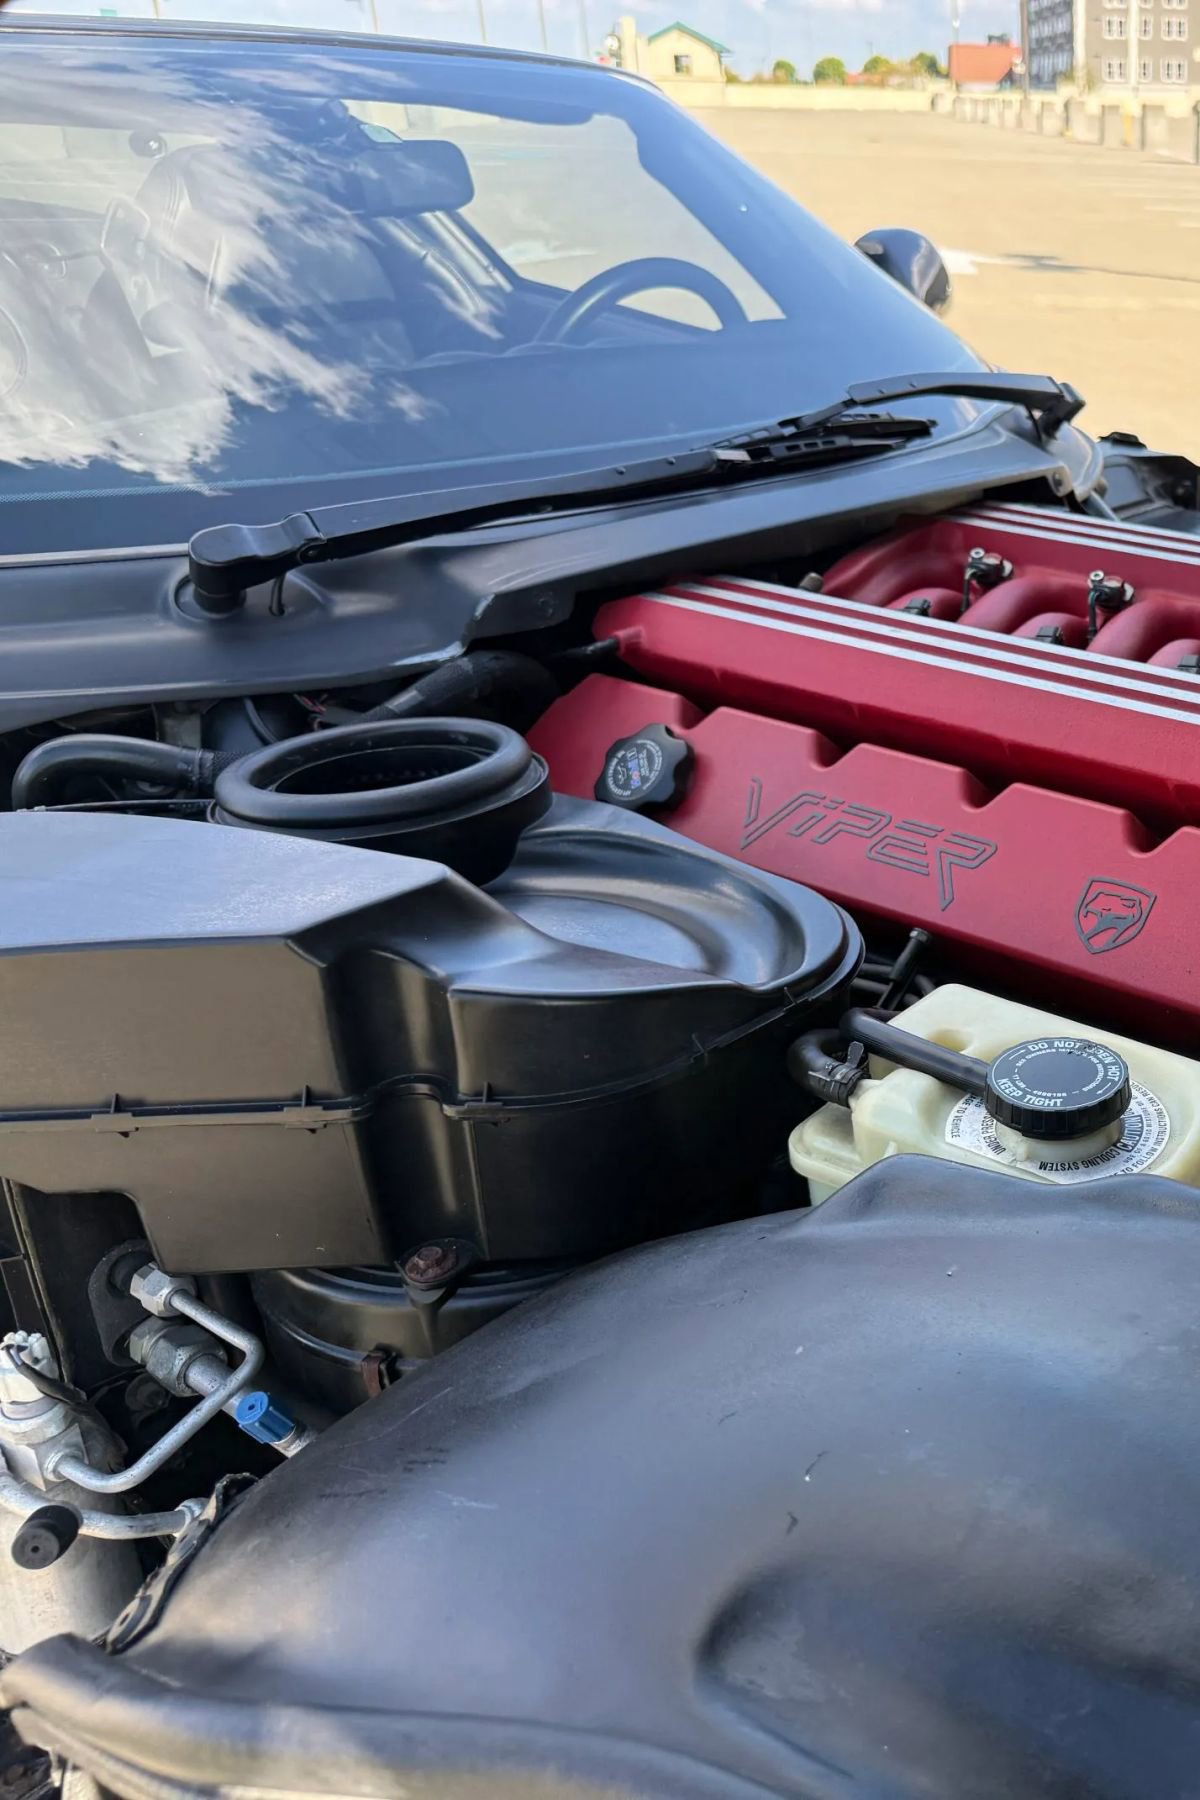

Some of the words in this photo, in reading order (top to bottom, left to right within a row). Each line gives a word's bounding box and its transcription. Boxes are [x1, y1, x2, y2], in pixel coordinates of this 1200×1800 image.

[741, 777, 997, 911] VIPER
[1027, 1042, 1049, 1052] DO
[1053, 1040, 1083, 1049] NOT
[1106, 1065, 1120, 1081] HOT
[997, 1078, 1023, 1098] KEEP
[1023, 1094, 1064, 1107] TIGHT
[1130, 1082, 1149, 1097] RESUL
[1117, 1116, 1142, 1152] CAUTION
[983, 1135, 1006, 1156] UNDER
[1038, 1160, 1080, 1172] SYSTEM
[1081, 1150, 1120, 1168] COOLING
[1132, 1147, 1158, 1168] FOLLOW
